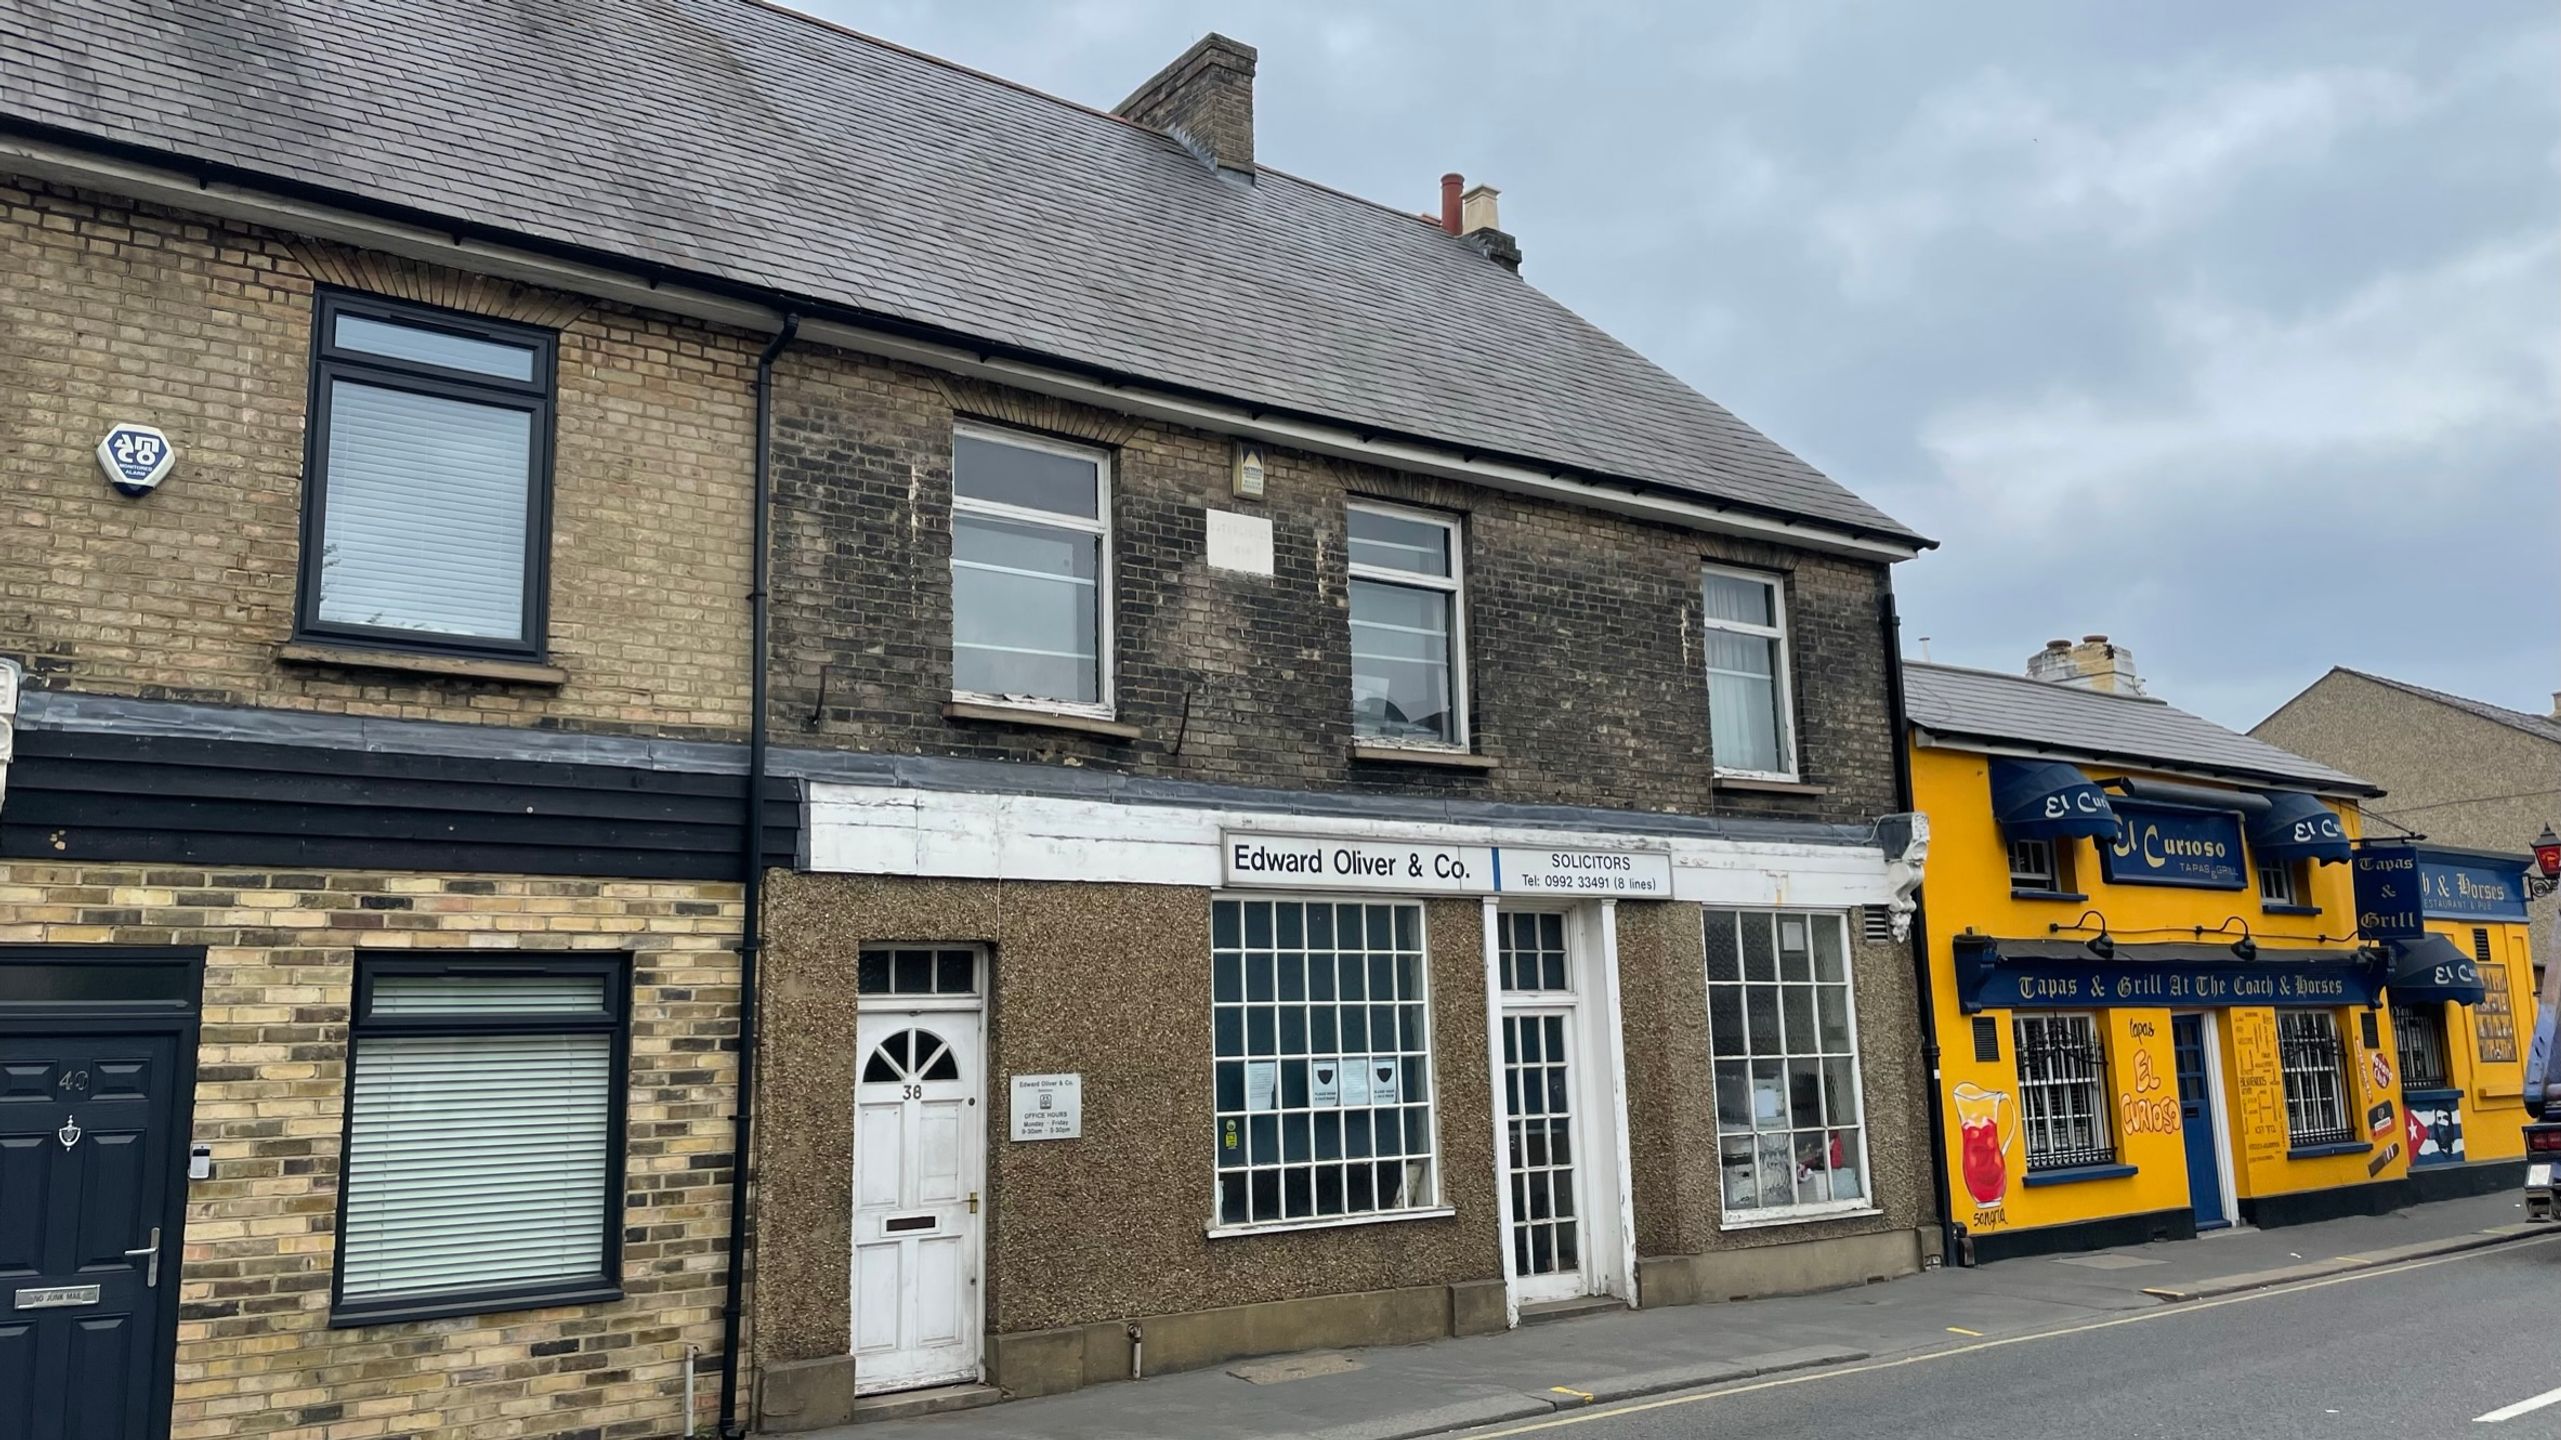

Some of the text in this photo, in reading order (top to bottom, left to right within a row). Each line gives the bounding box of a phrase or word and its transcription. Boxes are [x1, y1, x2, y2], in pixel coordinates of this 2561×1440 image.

[2045, 794, 2071, 818] El
[2294, 821, 2316, 842] El
[2144, 824, 2226, 868] Curioso
[1235, 844, 1470, 879] Edward Oliver & Co.
[1551, 853, 1631, 871] SOLICITORS
[2180, 862, 2210, 874] TAPAS
[2359, 856, 2413, 872] Tapas
[1522, 874, 1656, 891] Tel: 0992 33491 (8 lines)
[2381, 883, 2396, 898] &
[2438, 874, 2450, 897] &
[2456, 872, 2505, 900] Horses
[2477, 901, 2492, 910] PUB
[2361, 911, 2415, 929] Grill
[2434, 965, 2453, 984] El
[2019, 974, 2343, 999] Tapas & Grill At The Coach & Horses
[2129, 1017, 2155, 1045] tapas
[59, 1070, 89, 1091] 40
[2133, 1048, 2161, 1093] EL
[902, 1084, 922, 1100] 38
[2121, 1093, 2181, 1136] CURIOSO
[1973, 1208, 2008, 1231] sangria
